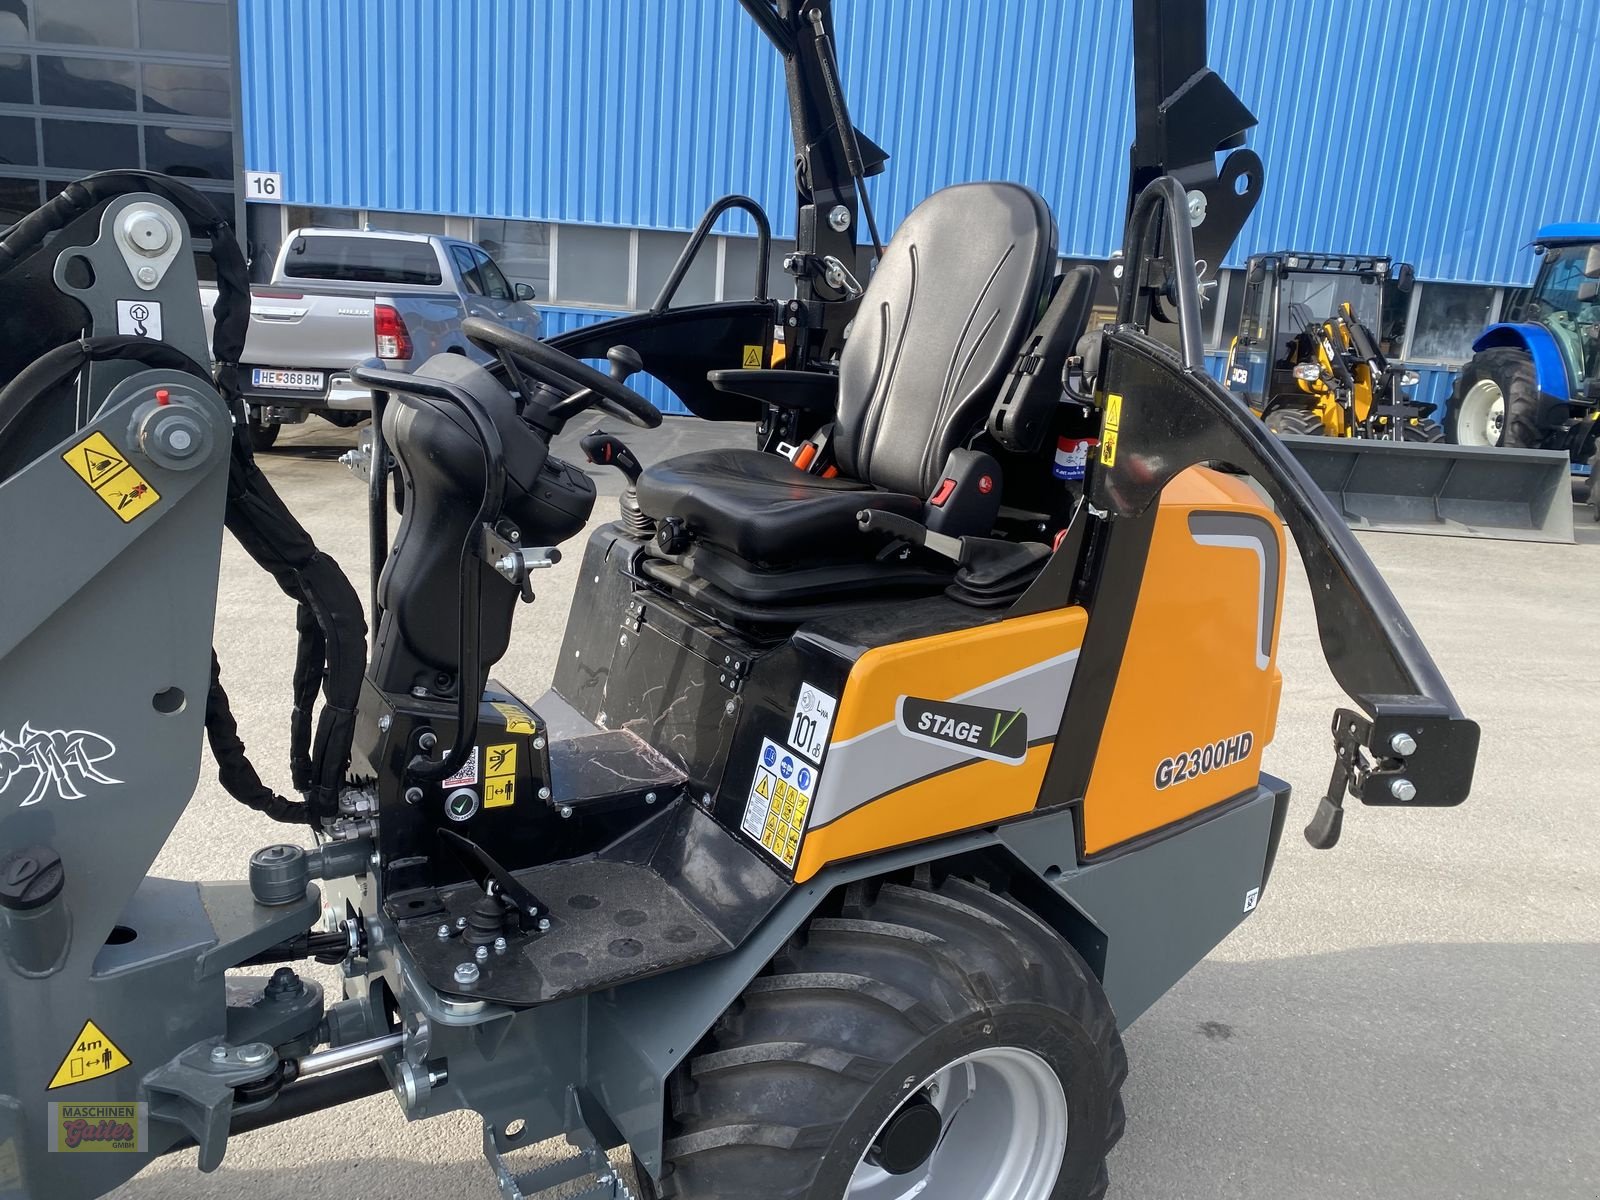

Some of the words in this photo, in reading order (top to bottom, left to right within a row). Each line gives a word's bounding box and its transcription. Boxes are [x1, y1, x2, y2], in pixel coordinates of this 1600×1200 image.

[253, 177, 275, 195] 16
[283, 372, 303, 385] 368
[304, 373, 320, 386] BM
[1232, 368, 1248, 384] JCB
[793, 711, 818, 753] 101
[917, 711, 983, 744] STAGE
[1154, 730, 1254, 791] G2300HD
[77, 1040, 102, 1053] 4m
